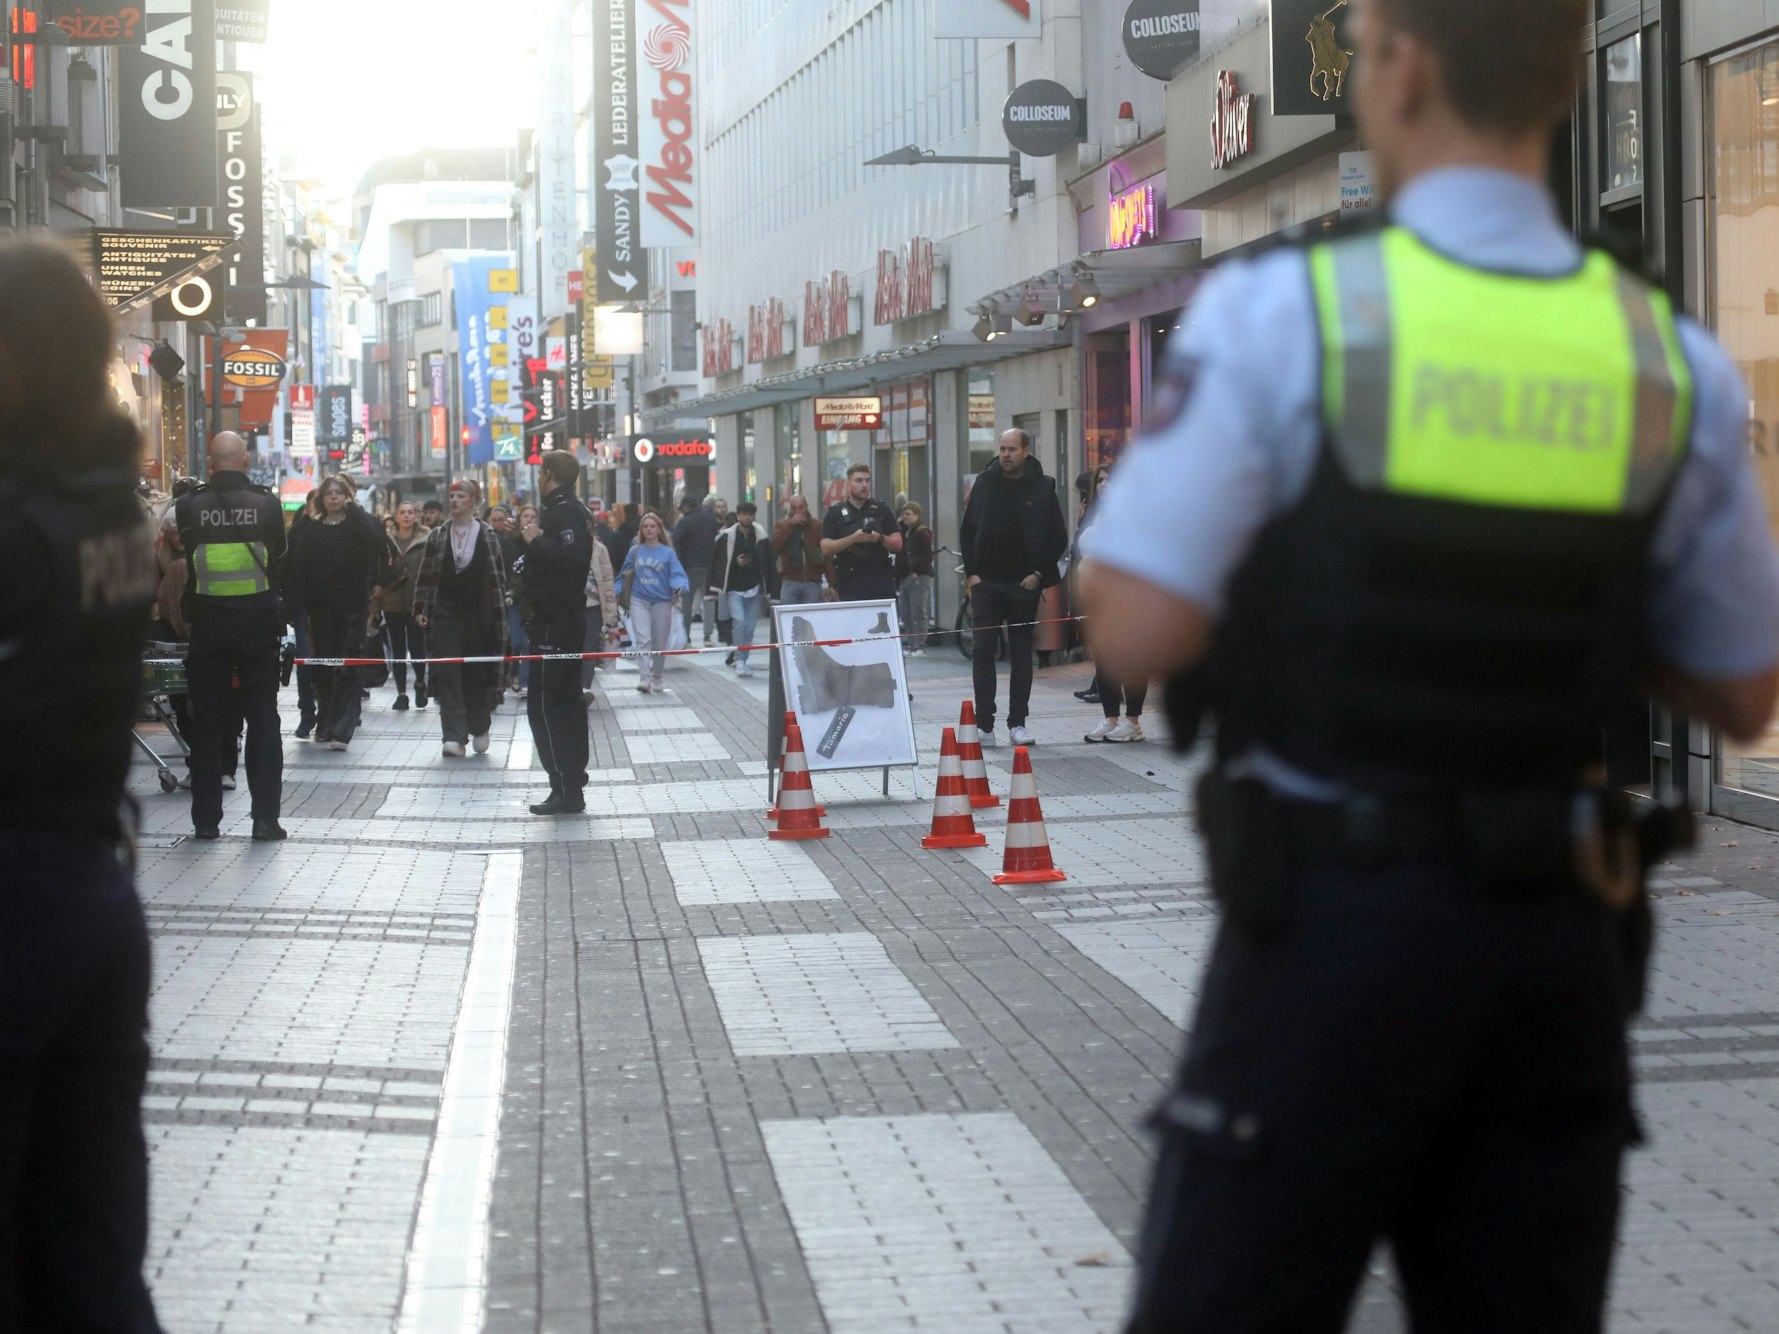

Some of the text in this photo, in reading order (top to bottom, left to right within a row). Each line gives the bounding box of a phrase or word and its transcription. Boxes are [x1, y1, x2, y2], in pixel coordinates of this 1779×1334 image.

[58, 6, 140, 39] size?
[141, 0, 193, 120] CA
[609, 0, 628, 145] LEDERATELIER
[216, 94, 247, 109] NLY
[1009, 105, 1071, 121] COLLOSEUM
[1341, 187, 1359, 197] Free
[614, 193, 631, 262] SANDY
[101, 237, 226, 245] GESCHENKARTIKEL
[224, 361, 279, 376] FOSSIL
[1409, 360, 1618, 453] POLIZEI
[200, 508, 258, 527] POLIZEI
